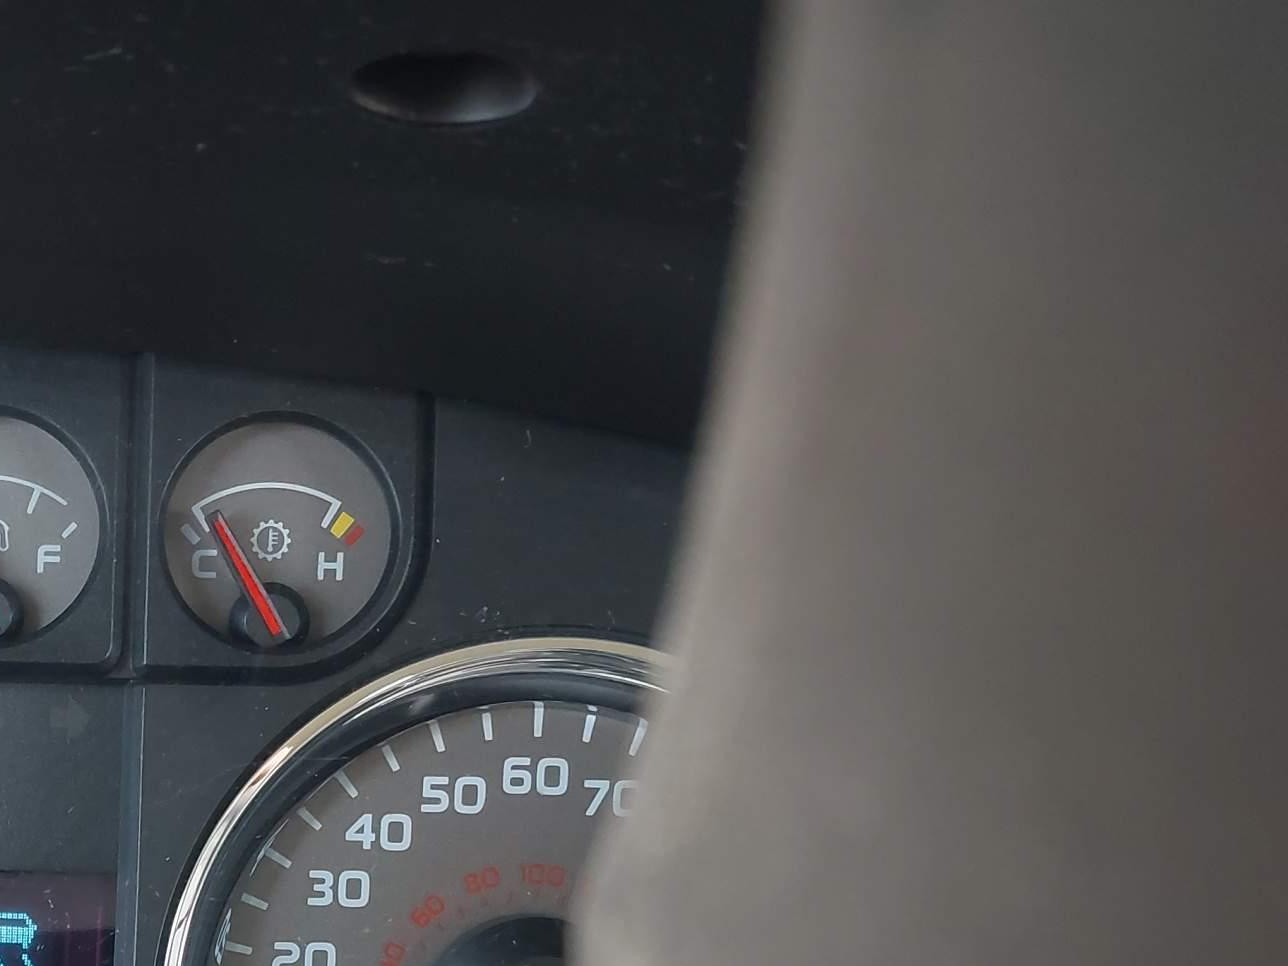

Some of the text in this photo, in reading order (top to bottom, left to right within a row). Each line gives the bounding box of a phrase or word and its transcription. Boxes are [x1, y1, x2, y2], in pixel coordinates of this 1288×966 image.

[37, 545, 61, 573] F
[192, 549, 217, 579] C
[317, 552, 344, 580] H
[502, 757, 569, 796] 60
[420, 776, 486, 814] 50
[344, 814, 412, 850] 40
[307, 871, 370, 907] 30
